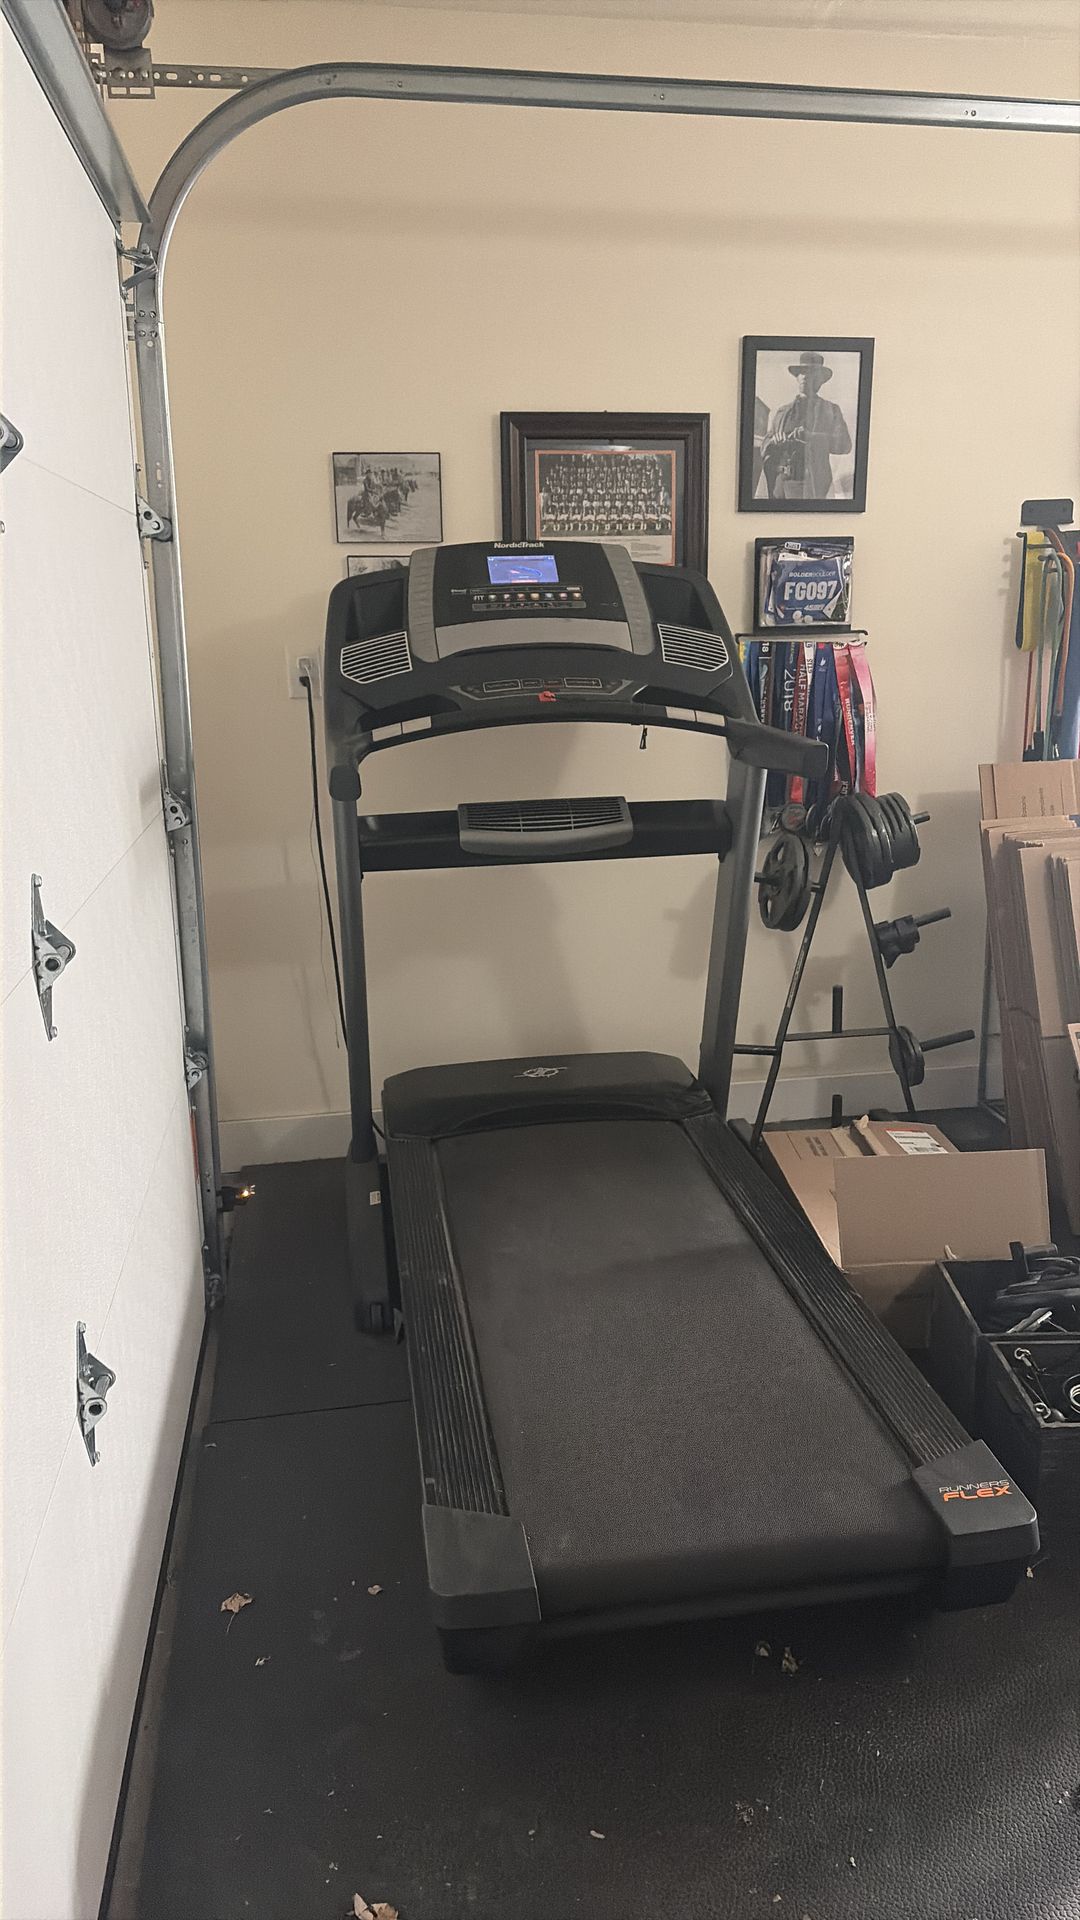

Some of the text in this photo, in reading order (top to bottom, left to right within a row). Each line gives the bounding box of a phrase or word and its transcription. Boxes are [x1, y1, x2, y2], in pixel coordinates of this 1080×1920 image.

[493, 541, 545, 549] NordicTrack
[784, 581, 838, 600] FG097
[798, 664, 808, 690] HALF
[783, 669, 796, 711] 2018
[939, 1480, 1010, 1493] RUNNERS
[943, 1486, 1013, 1502] FLEX
